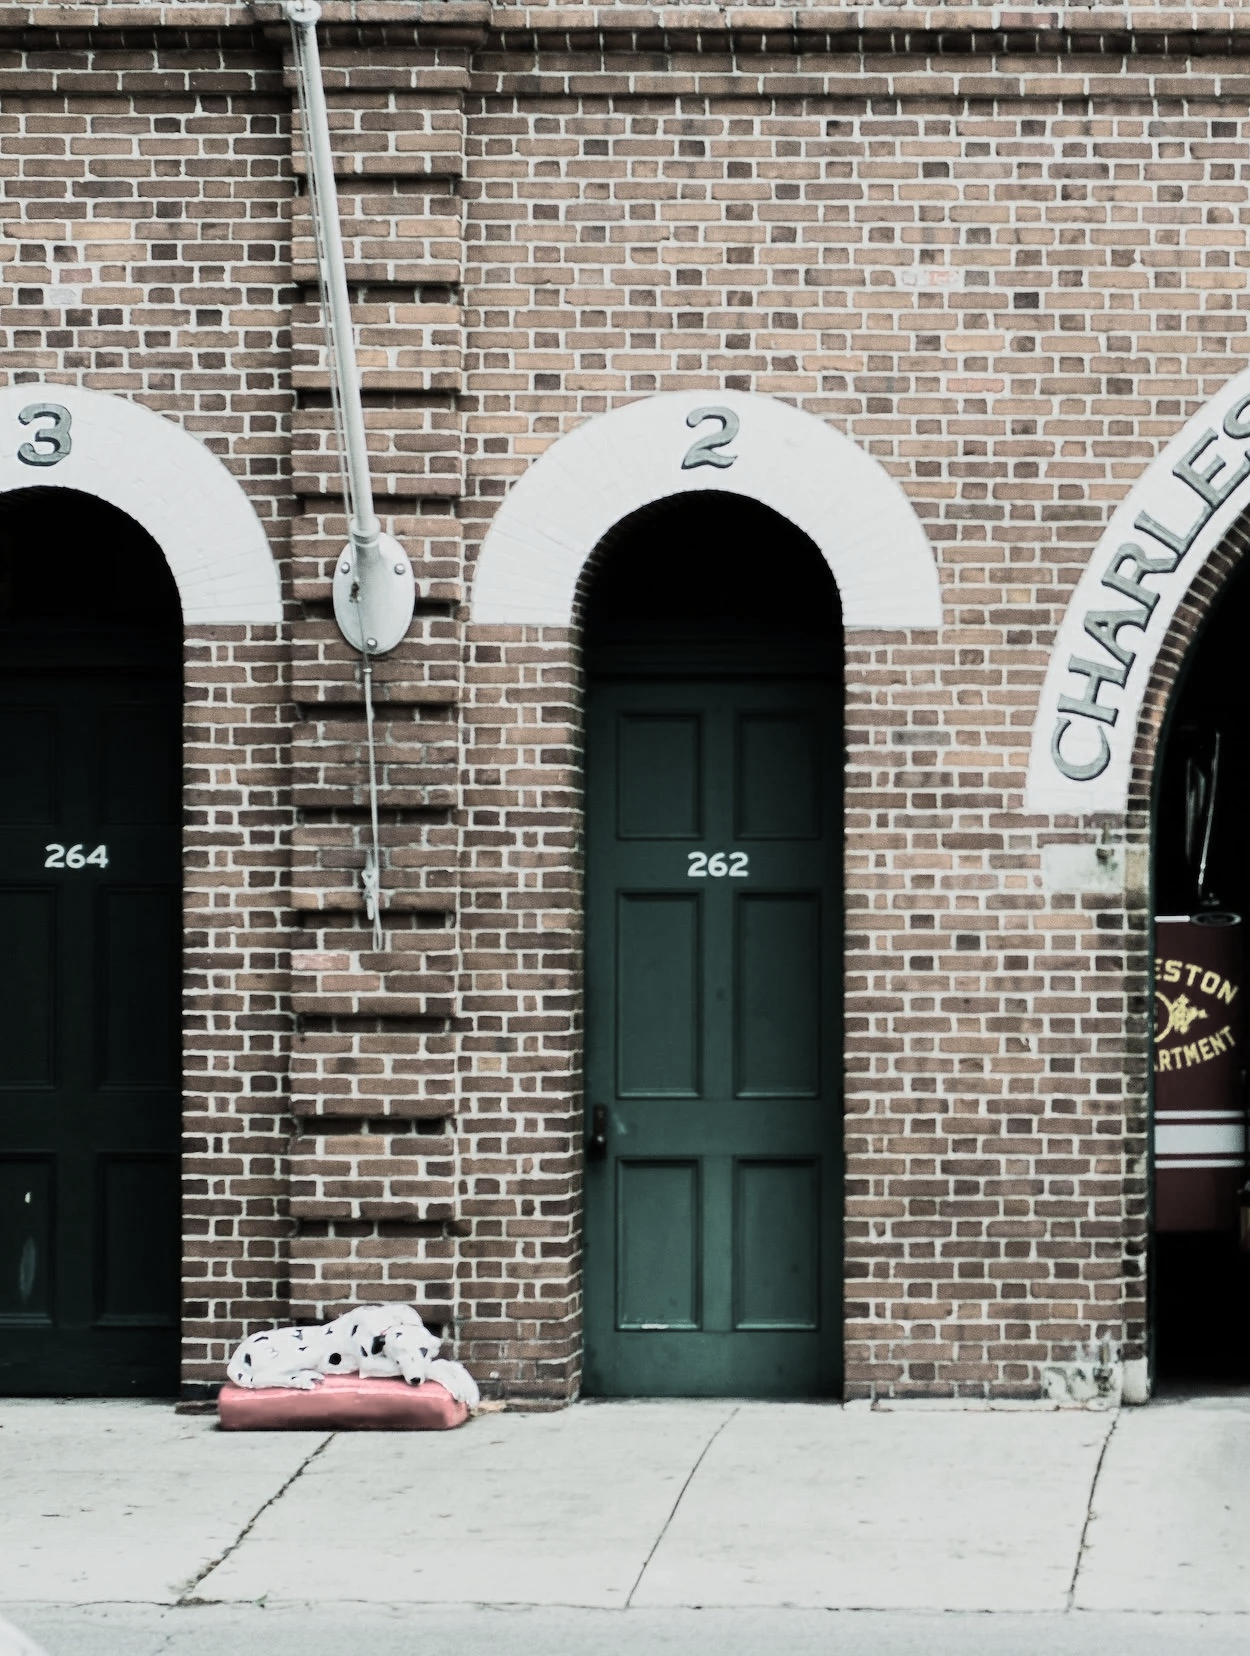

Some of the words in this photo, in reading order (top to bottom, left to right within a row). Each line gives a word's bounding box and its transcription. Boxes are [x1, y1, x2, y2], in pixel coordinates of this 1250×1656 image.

[17, 402, 73, 467] 3
[680, 405, 740, 470] 2
[44, 843, 109, 869] 264
[687, 851, 749, 877] 262
[1154, 1024, 1237, 1073] RTMENT
